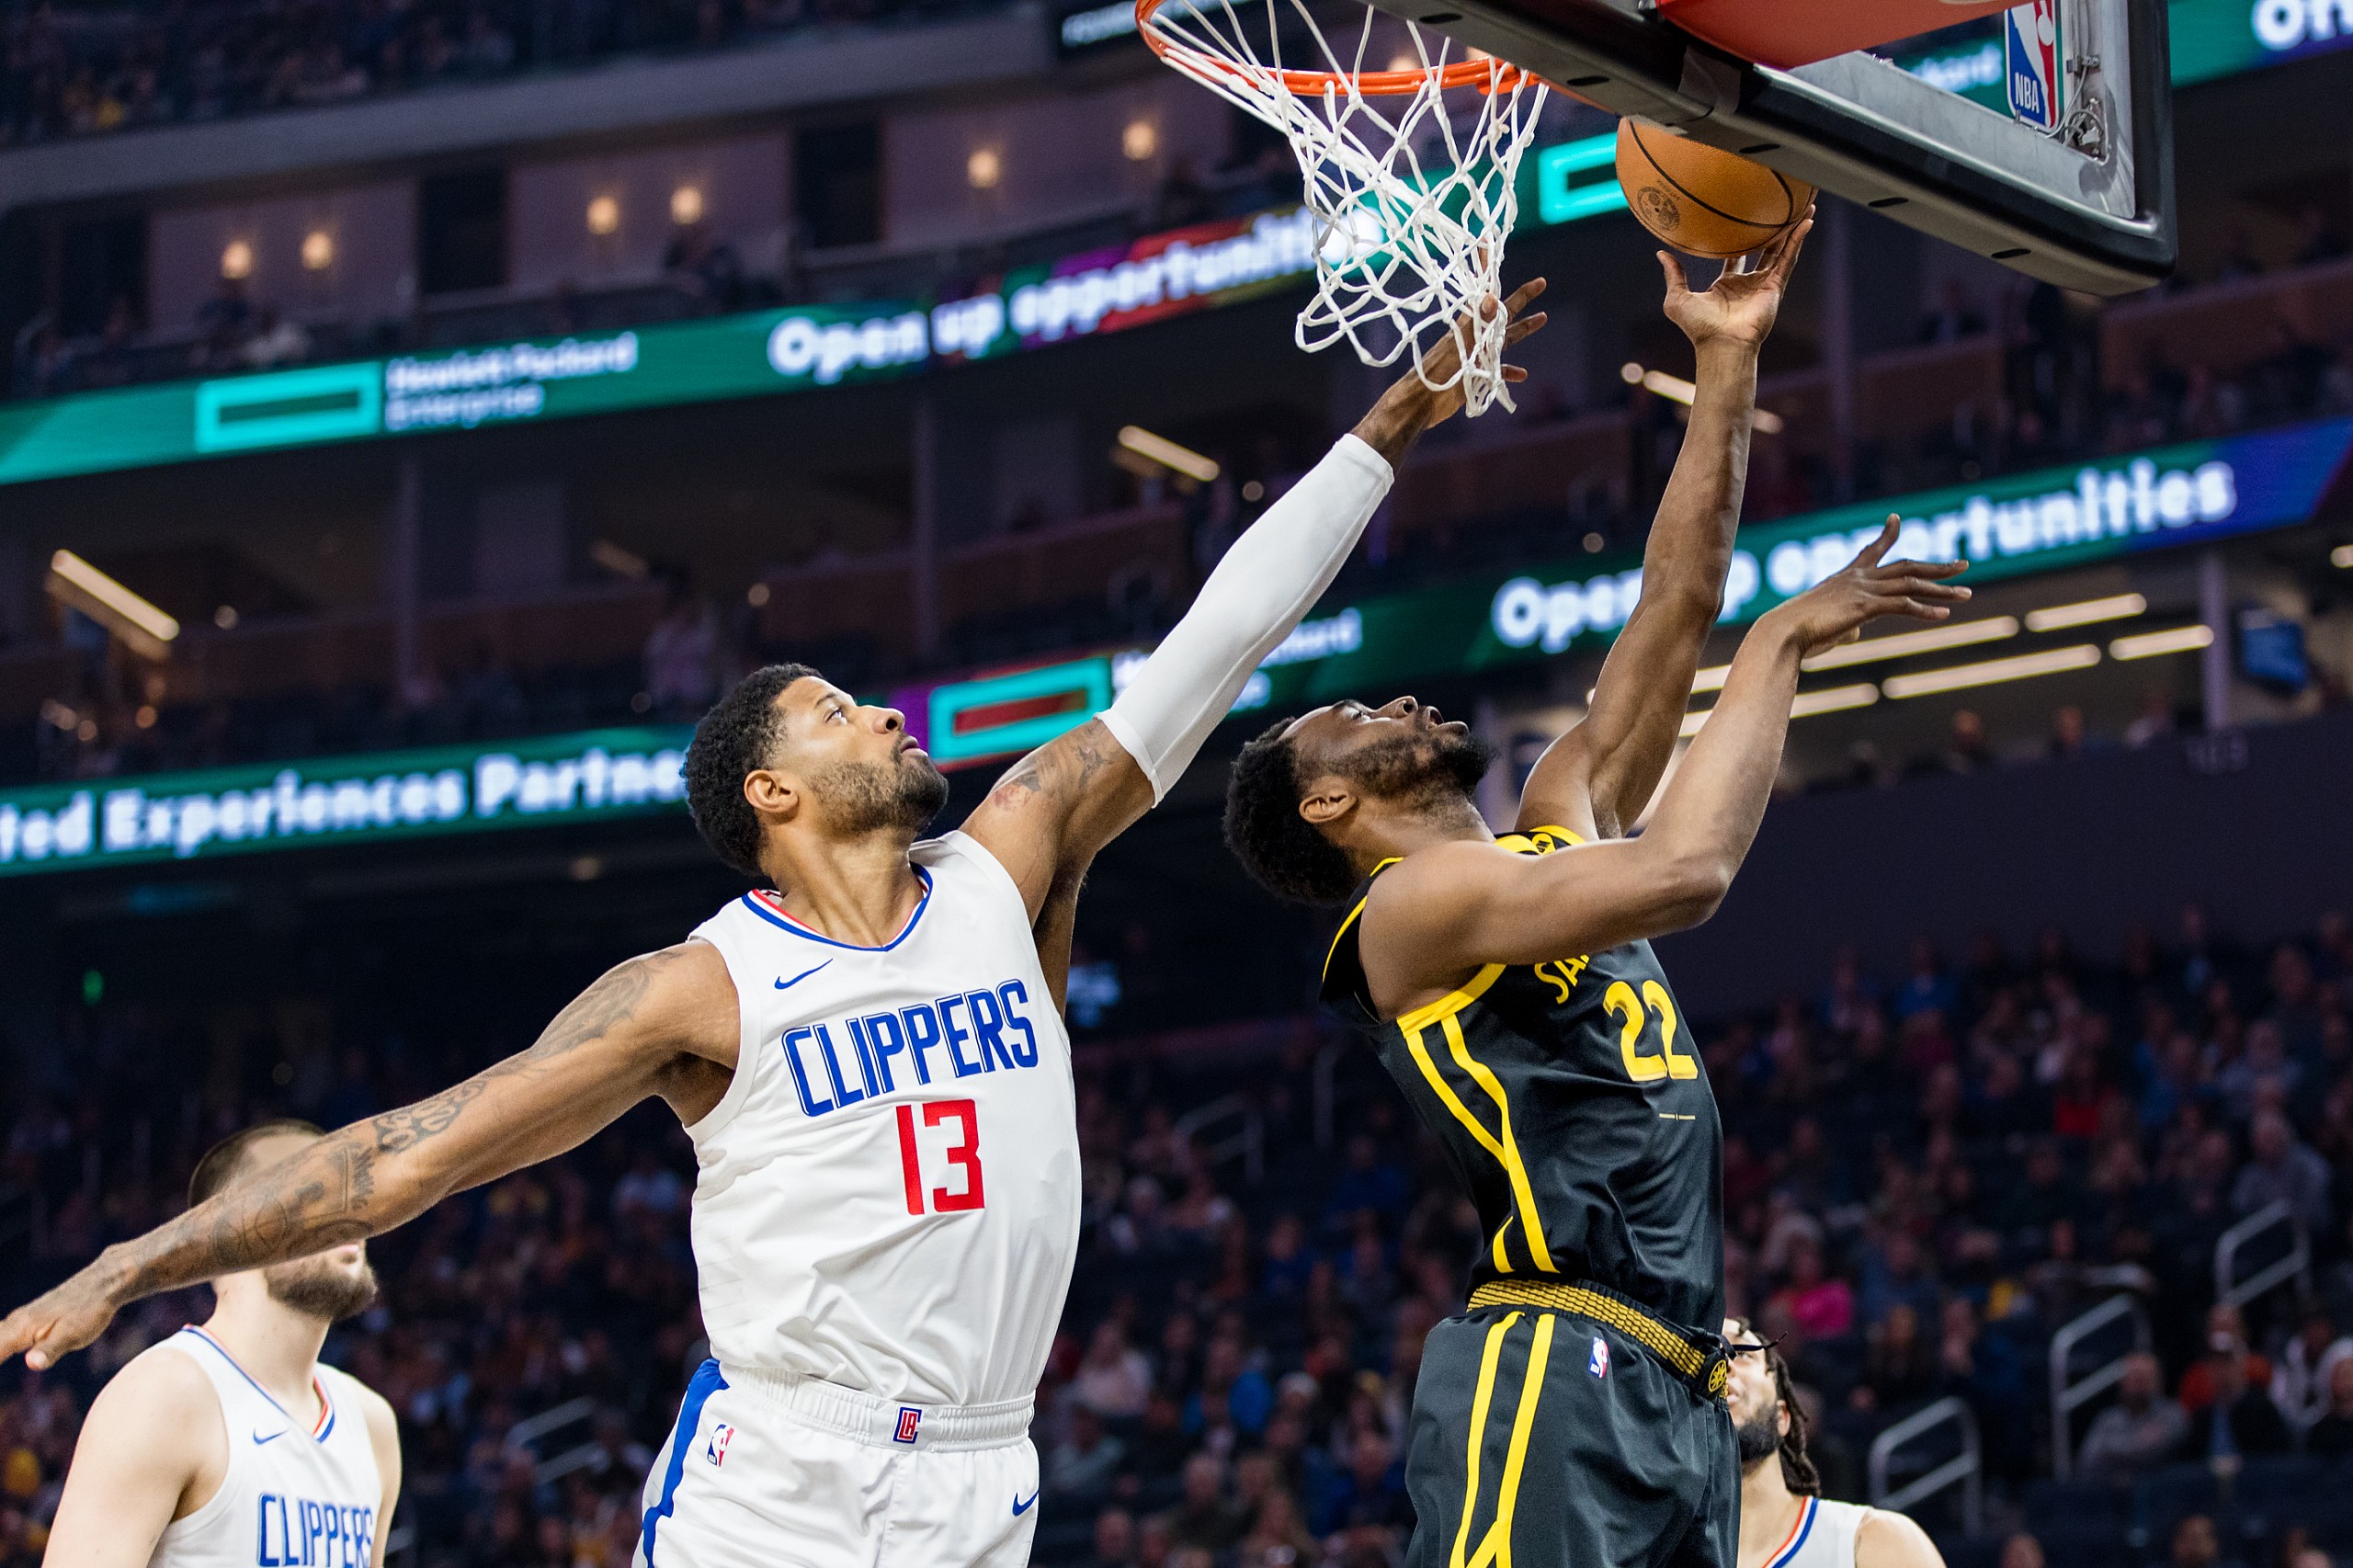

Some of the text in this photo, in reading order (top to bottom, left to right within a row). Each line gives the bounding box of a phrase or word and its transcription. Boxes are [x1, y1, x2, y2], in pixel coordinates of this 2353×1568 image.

[2015, 72, 2040, 114] NBA
[508, 331, 638, 381] Packard
[767, 316, 928, 385] Open
[930, 293, 1006, 359] up
[102, 768, 469, 859] Experiences
[1534, 954, 1589, 1005] SA
[781, 978, 1039, 1118] CLIPPERS
[1603, 980, 1698, 1081] 22
[896, 1098, 985, 1216] 13
